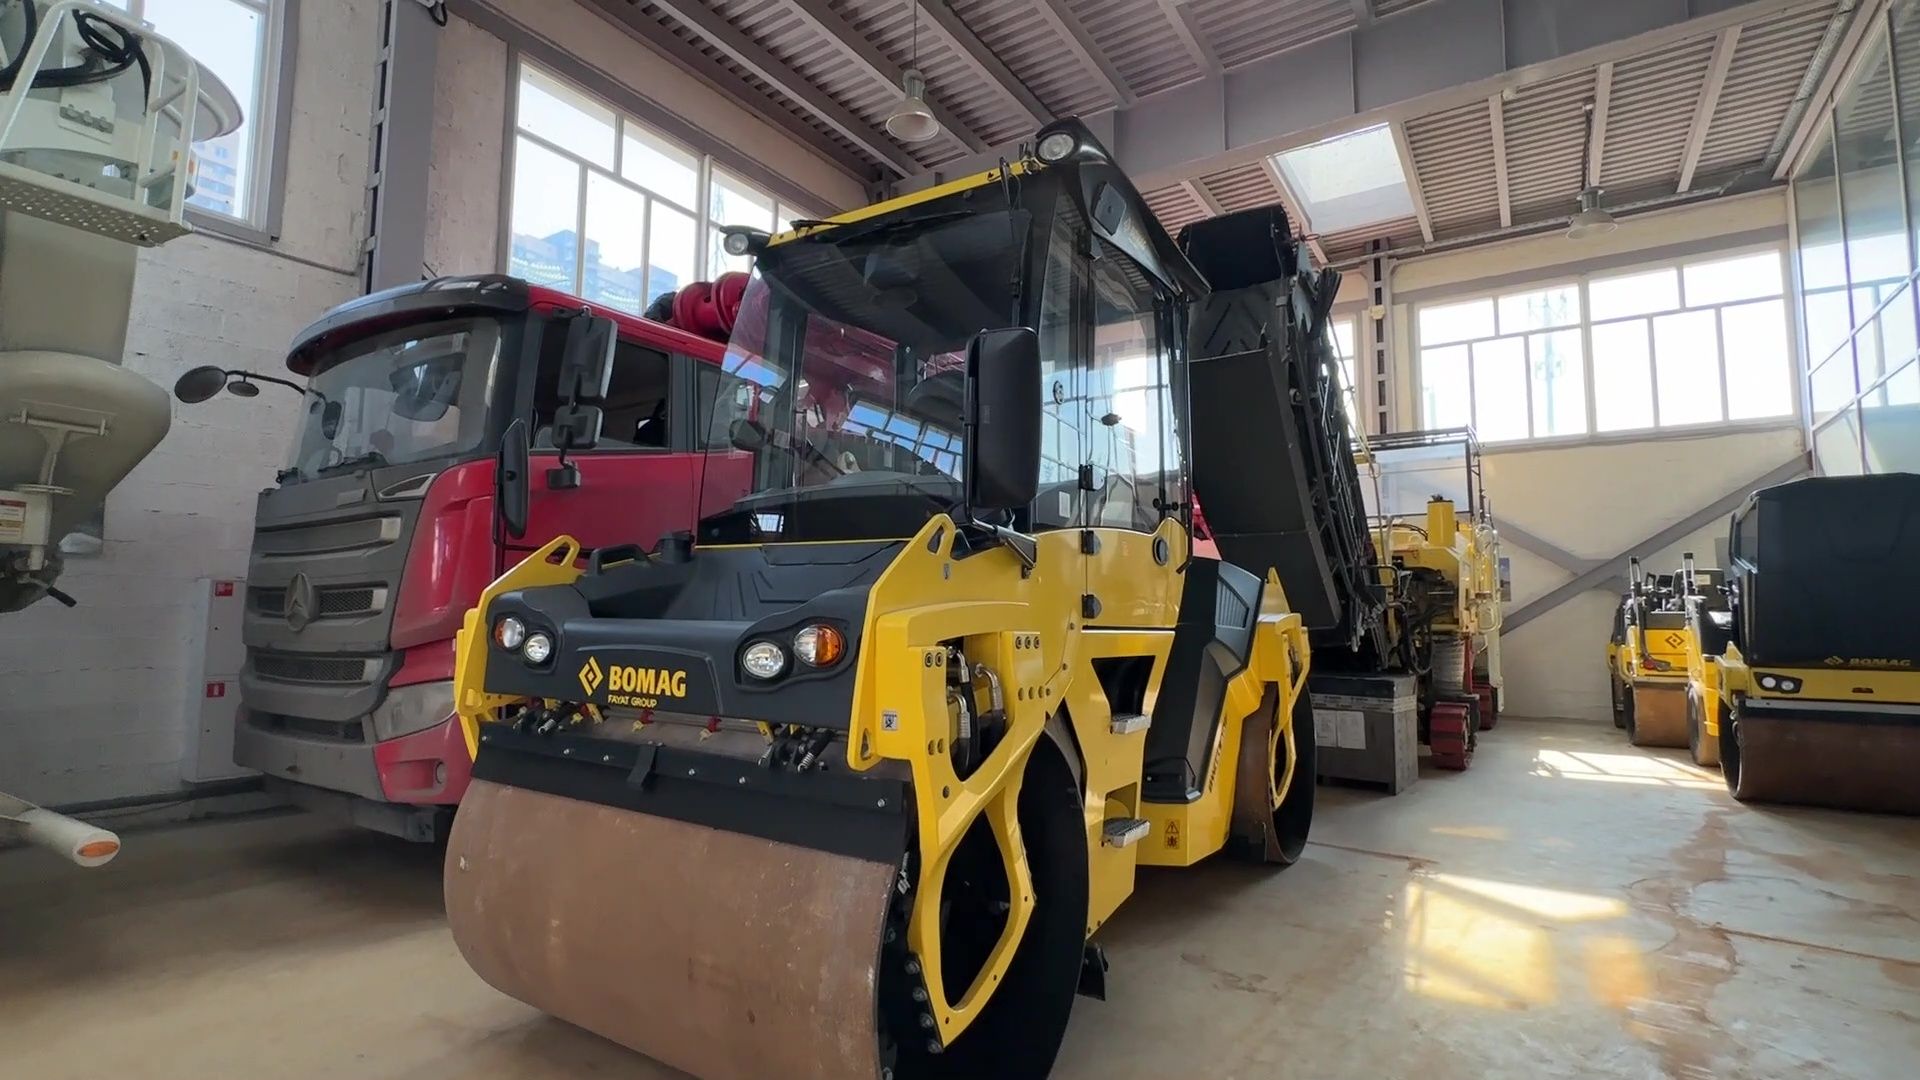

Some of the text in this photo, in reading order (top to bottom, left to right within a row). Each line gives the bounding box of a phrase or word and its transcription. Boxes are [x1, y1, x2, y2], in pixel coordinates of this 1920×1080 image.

[1849, 658, 1911, 667] BOMAG
[608, 665, 686, 698] BOMAG
[608, 694, 657, 708] FAYAT GROUP
